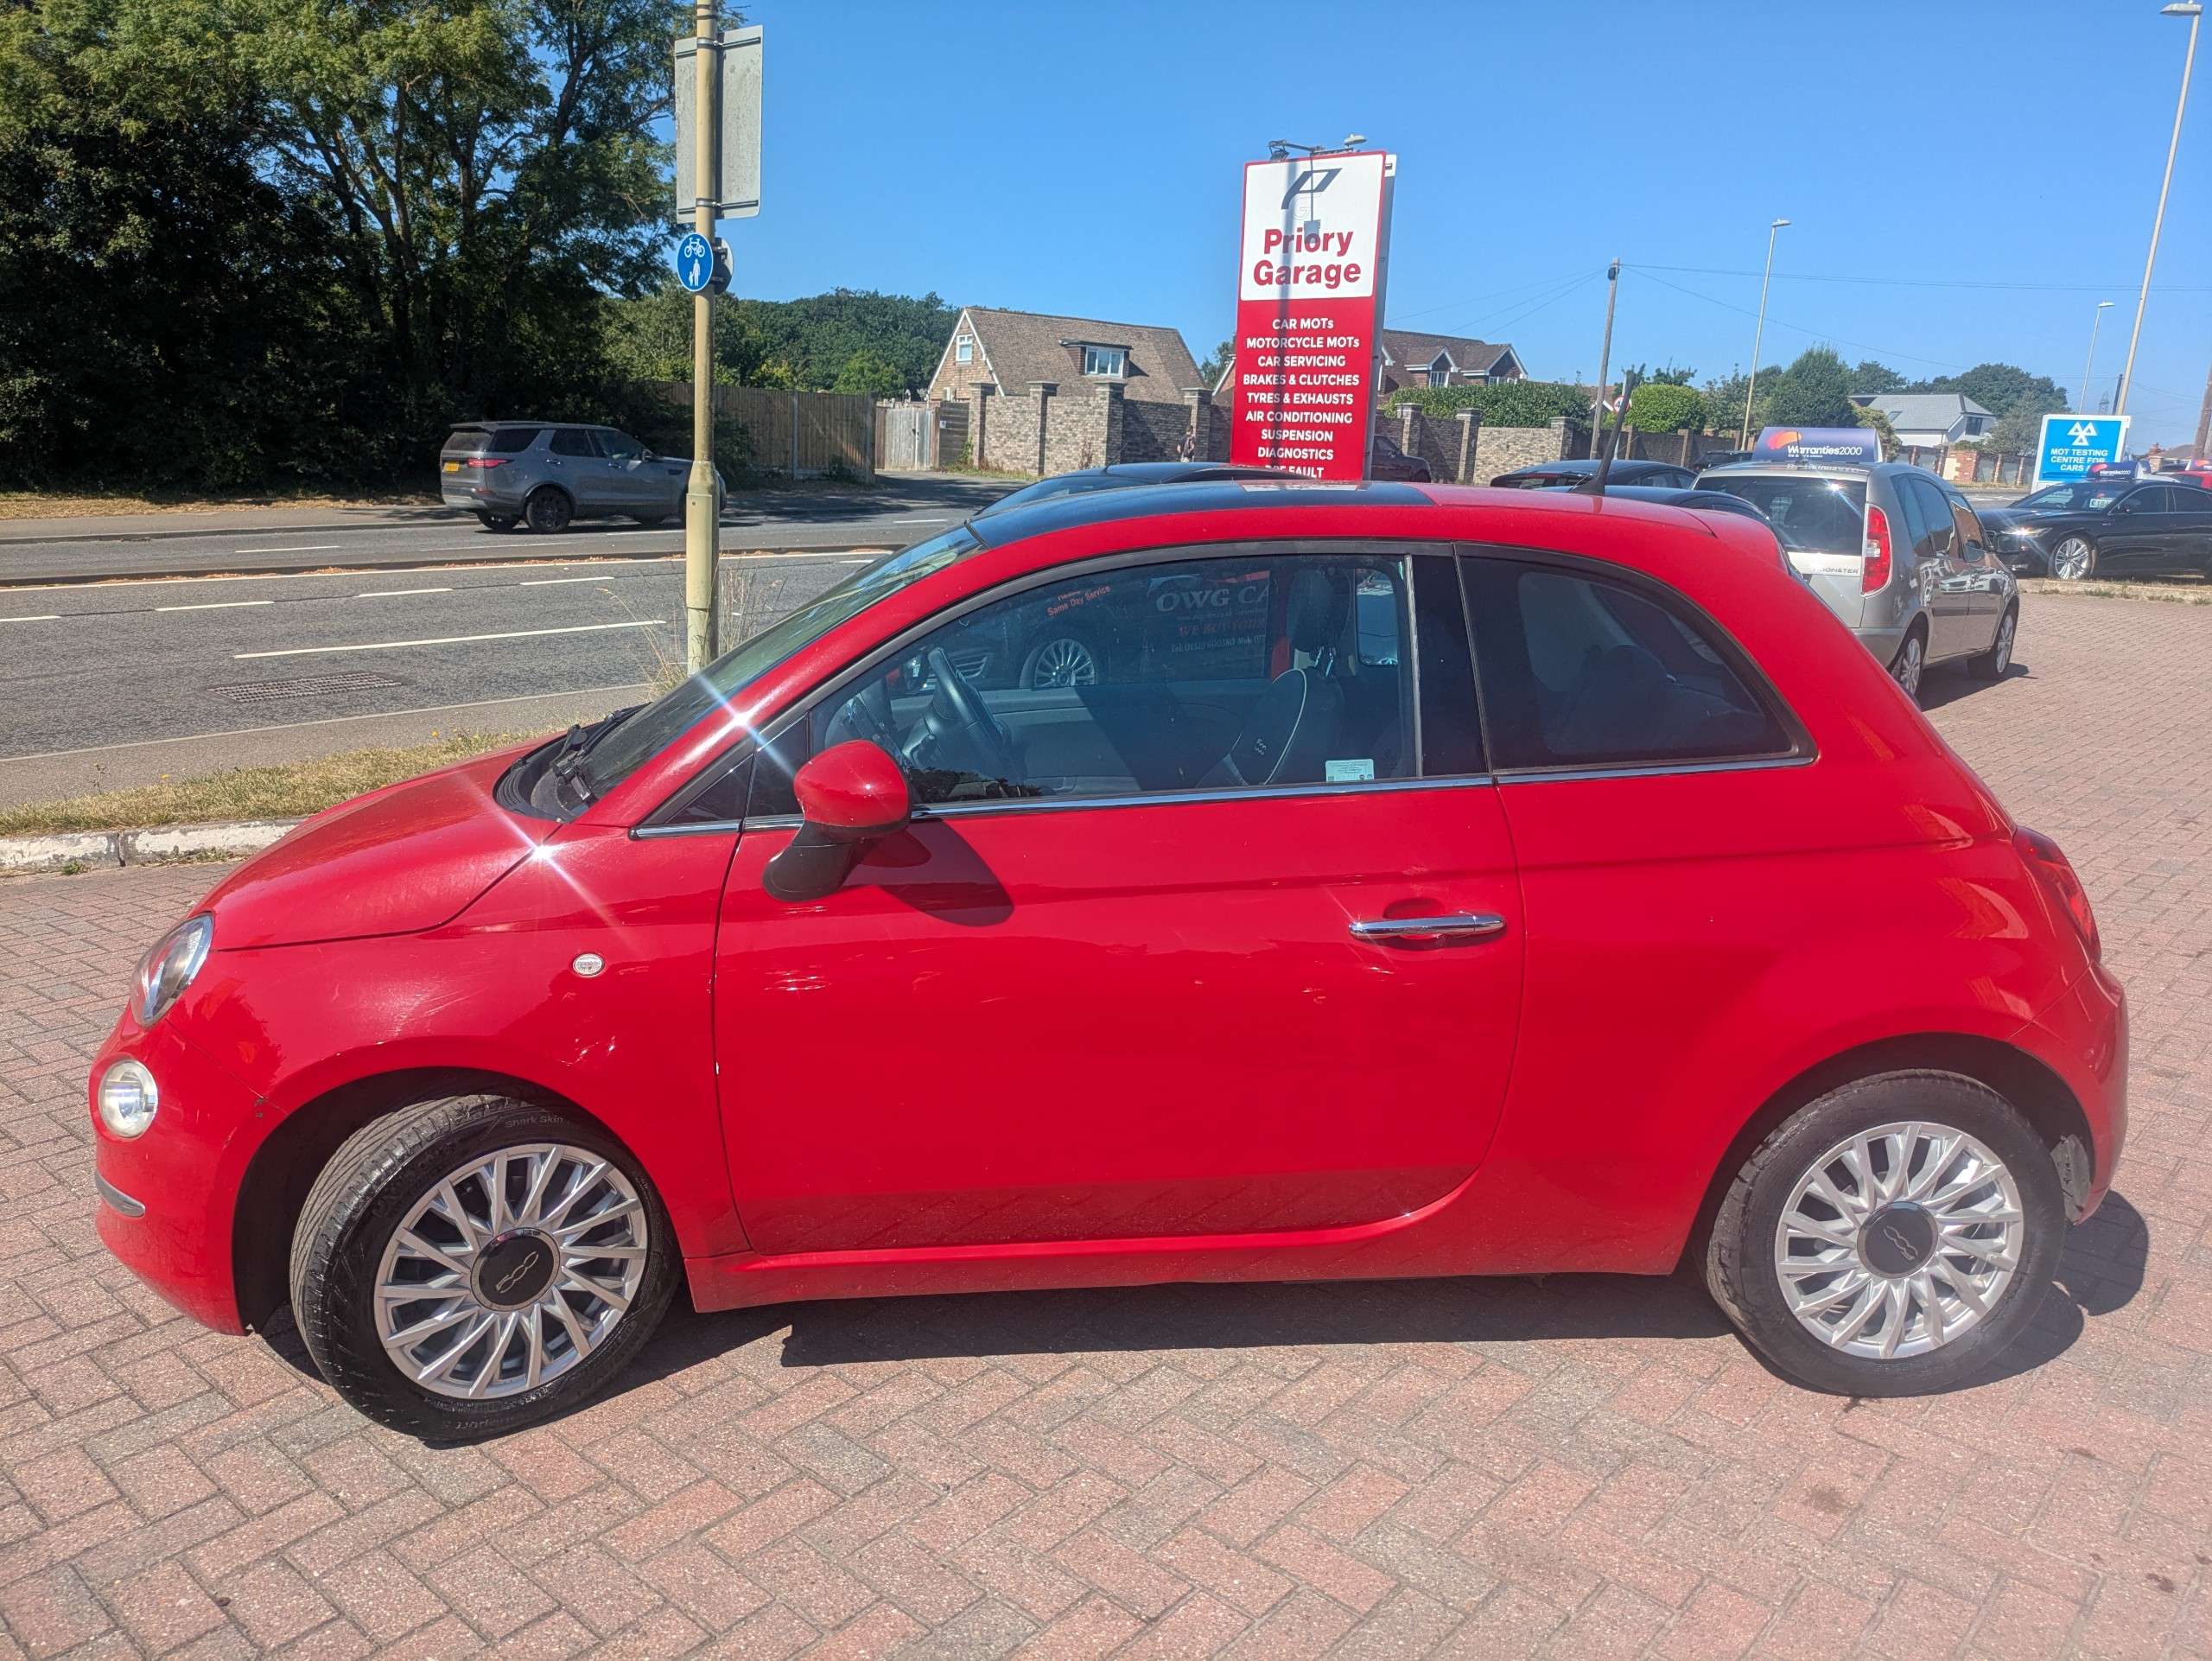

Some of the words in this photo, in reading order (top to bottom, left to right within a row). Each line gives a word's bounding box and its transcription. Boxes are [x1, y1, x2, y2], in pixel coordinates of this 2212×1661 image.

[1263, 227, 1354, 257] Priory
[1253, 259, 1362, 290] Garage
[1272, 319, 1297, 330] CAR
[1300, 318, 1334, 329] MOTs
[1246, 336, 1324, 349] MOTORCYCLE
[1326, 336, 1360, 348] MOTs
[1257, 356, 1281, 366] CAR
[1283, 355, 1346, 366] SERVICING
[1243, 374, 1286, 385] BRAKES
[1288, 374, 1296, 385] &
[1299, 374, 1359, 386] CLUTCHES
[1247, 392, 1281, 404] TYRES
[1282, 393, 1291, 404] &
[1293, 392, 1354, 405] EXHAUSTS
[1245, 410, 1264, 422] AIR
[1267, 410, 1353, 423] CONDITIONING
[1261, 429, 1333, 442] SUSPENSION
[1257, 447, 1334, 461] DIAGNOSTICS
[1288, 465, 1325, 478] FAULT
[1046, 602, 1070, 616] Same
[1070, 596, 1085, 607] Day
[1084, 586, 1112, 601] Service
